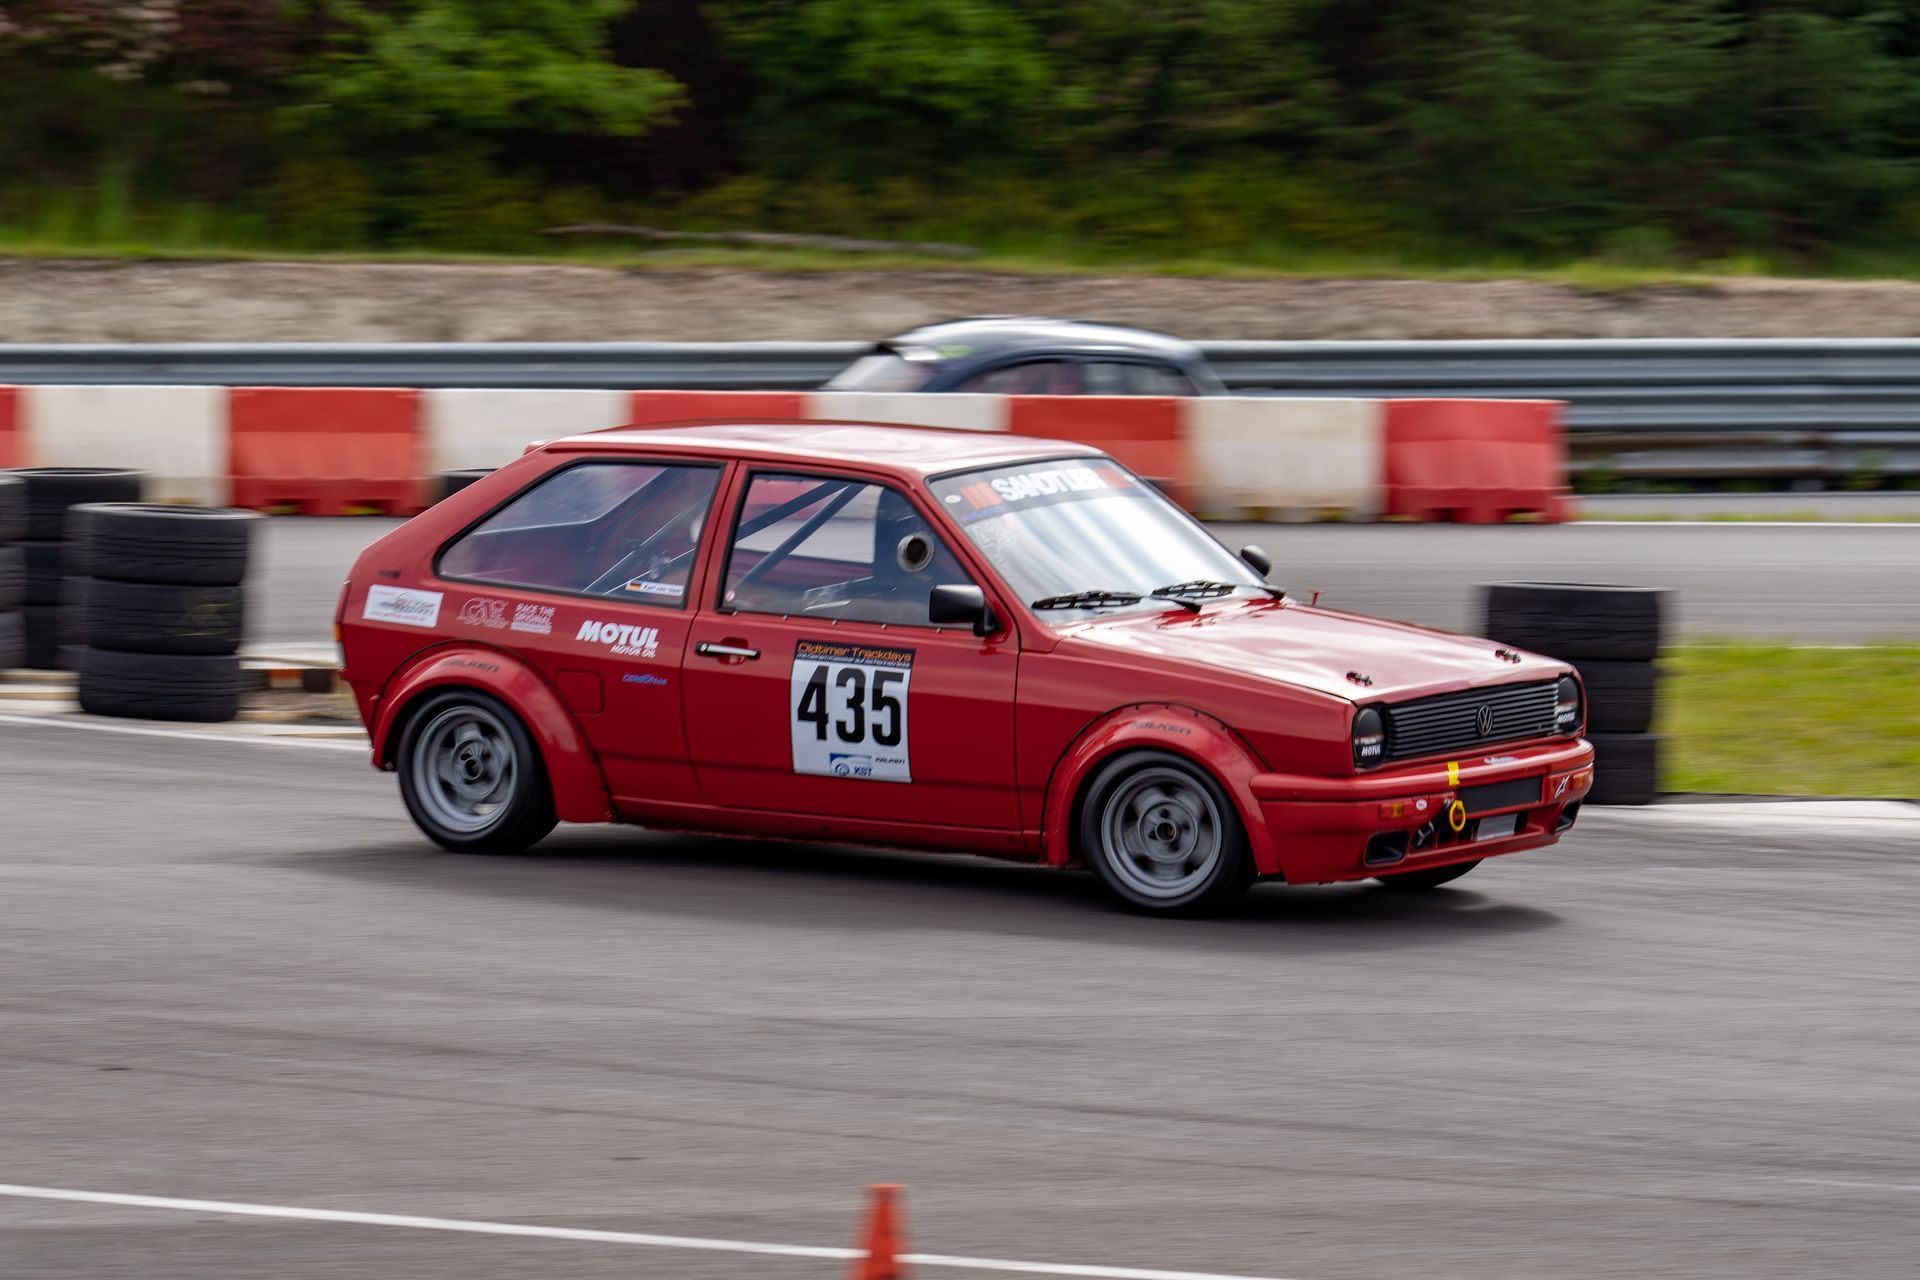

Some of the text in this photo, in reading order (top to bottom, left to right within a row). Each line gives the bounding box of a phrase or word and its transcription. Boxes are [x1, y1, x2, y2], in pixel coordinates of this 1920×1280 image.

[991, 467, 1108, 501] SANDTLER
[575, 619, 659, 649] MOTUL
[609, 644, 657, 659] MOTOR OIL
[798, 642, 850, 657] Oldtimer
[851, 646, 912, 662] Trackdays
[797, 665, 904, 746] 435
[1556, 711, 1576, 723] MOTUL
[1361, 743, 1381, 757] MOTUL
